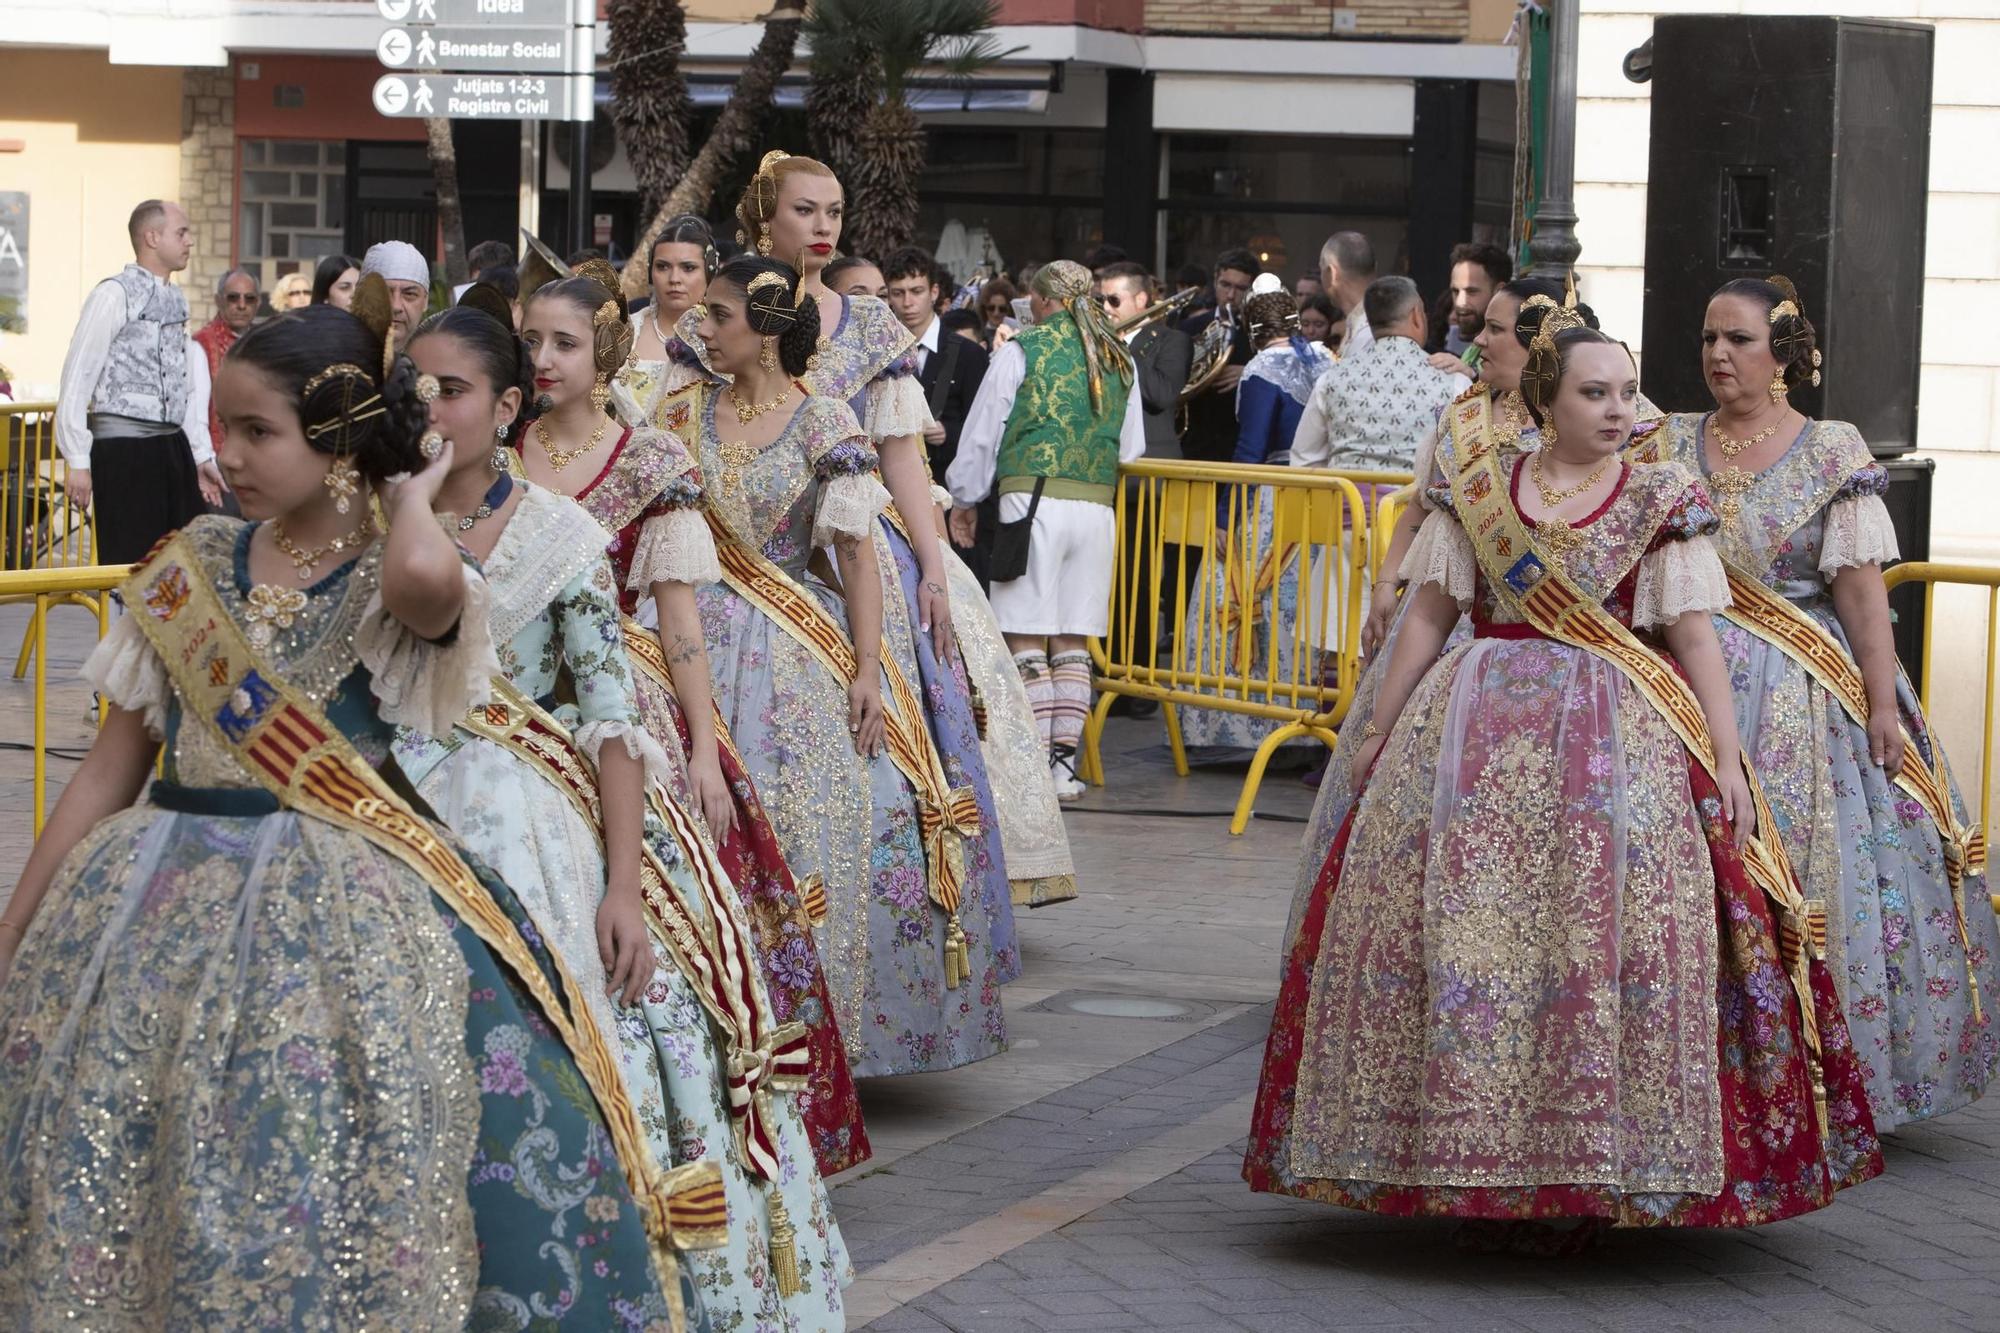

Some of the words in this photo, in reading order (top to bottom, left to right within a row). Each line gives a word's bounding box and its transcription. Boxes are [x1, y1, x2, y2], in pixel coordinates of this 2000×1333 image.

[439, 40, 509, 57] Benestar
[512, 41, 561, 58] Social
[453, 78, 504, 97] Jutjats
[508, 79, 546, 94] 1-2-3
[448, 97, 511, 116] Registre
[515, 98, 549, 114] Civil
[1477, 506, 1504, 536] 2024
[180, 617, 216, 667] 2024
